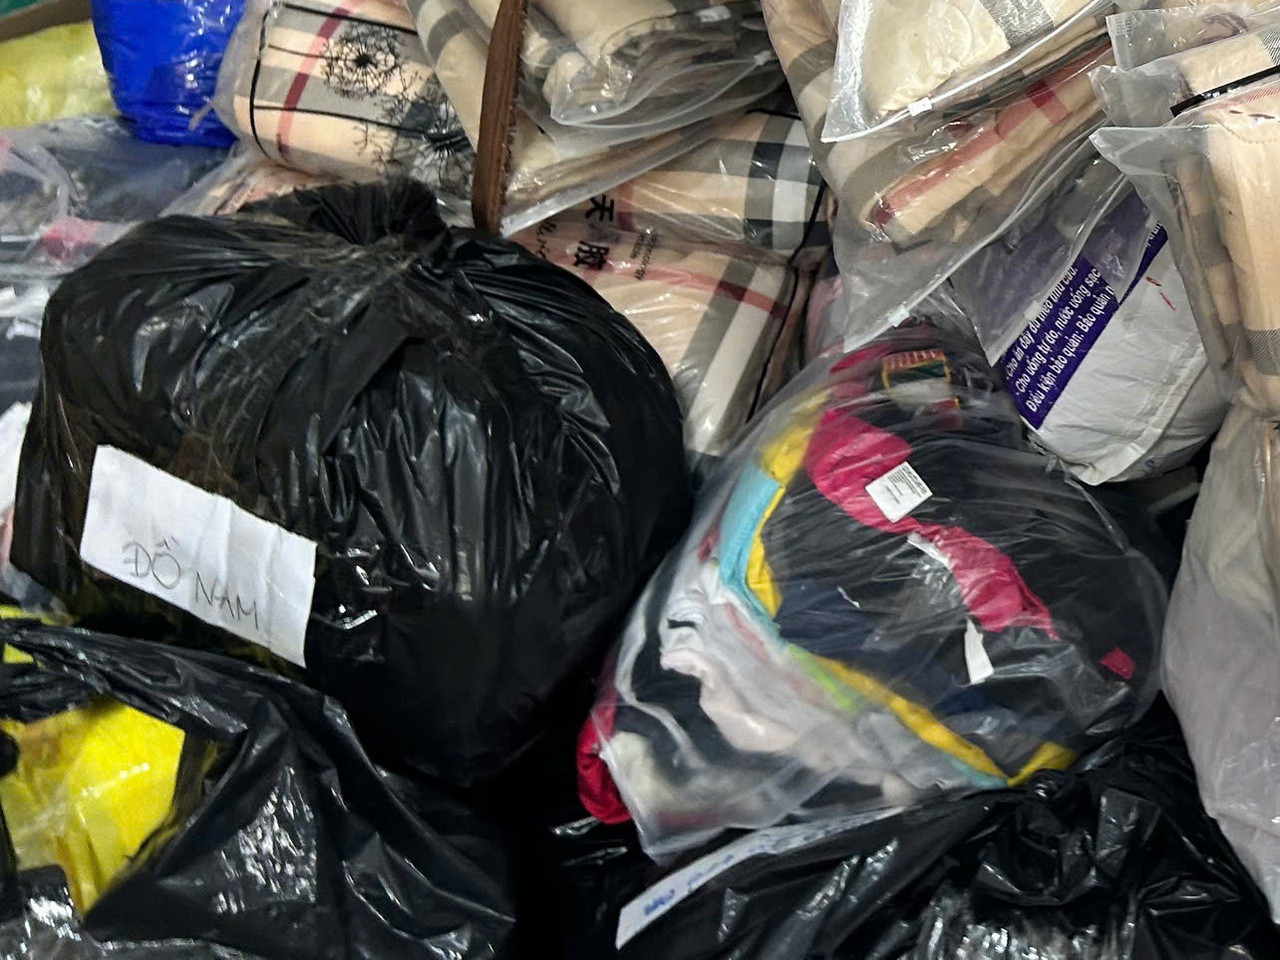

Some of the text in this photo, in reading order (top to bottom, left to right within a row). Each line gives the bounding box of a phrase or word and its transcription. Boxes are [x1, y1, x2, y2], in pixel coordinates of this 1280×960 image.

[1025, 351, 1047, 376] uống
[1044, 329, 1062, 345] do,
[1054, 306, 1075, 331] nước
[1068, 284, 1091, 309] uống
[1025, 389, 1046, 413] Điều
[1048, 355, 1068, 374] bảo
[1062, 330, 1085, 358] quản:
[1075, 313, 1097, 333] Bảo
[1090, 293, 1111, 315] quản
[122, 536, 261, 624] ĐỒ NAM
